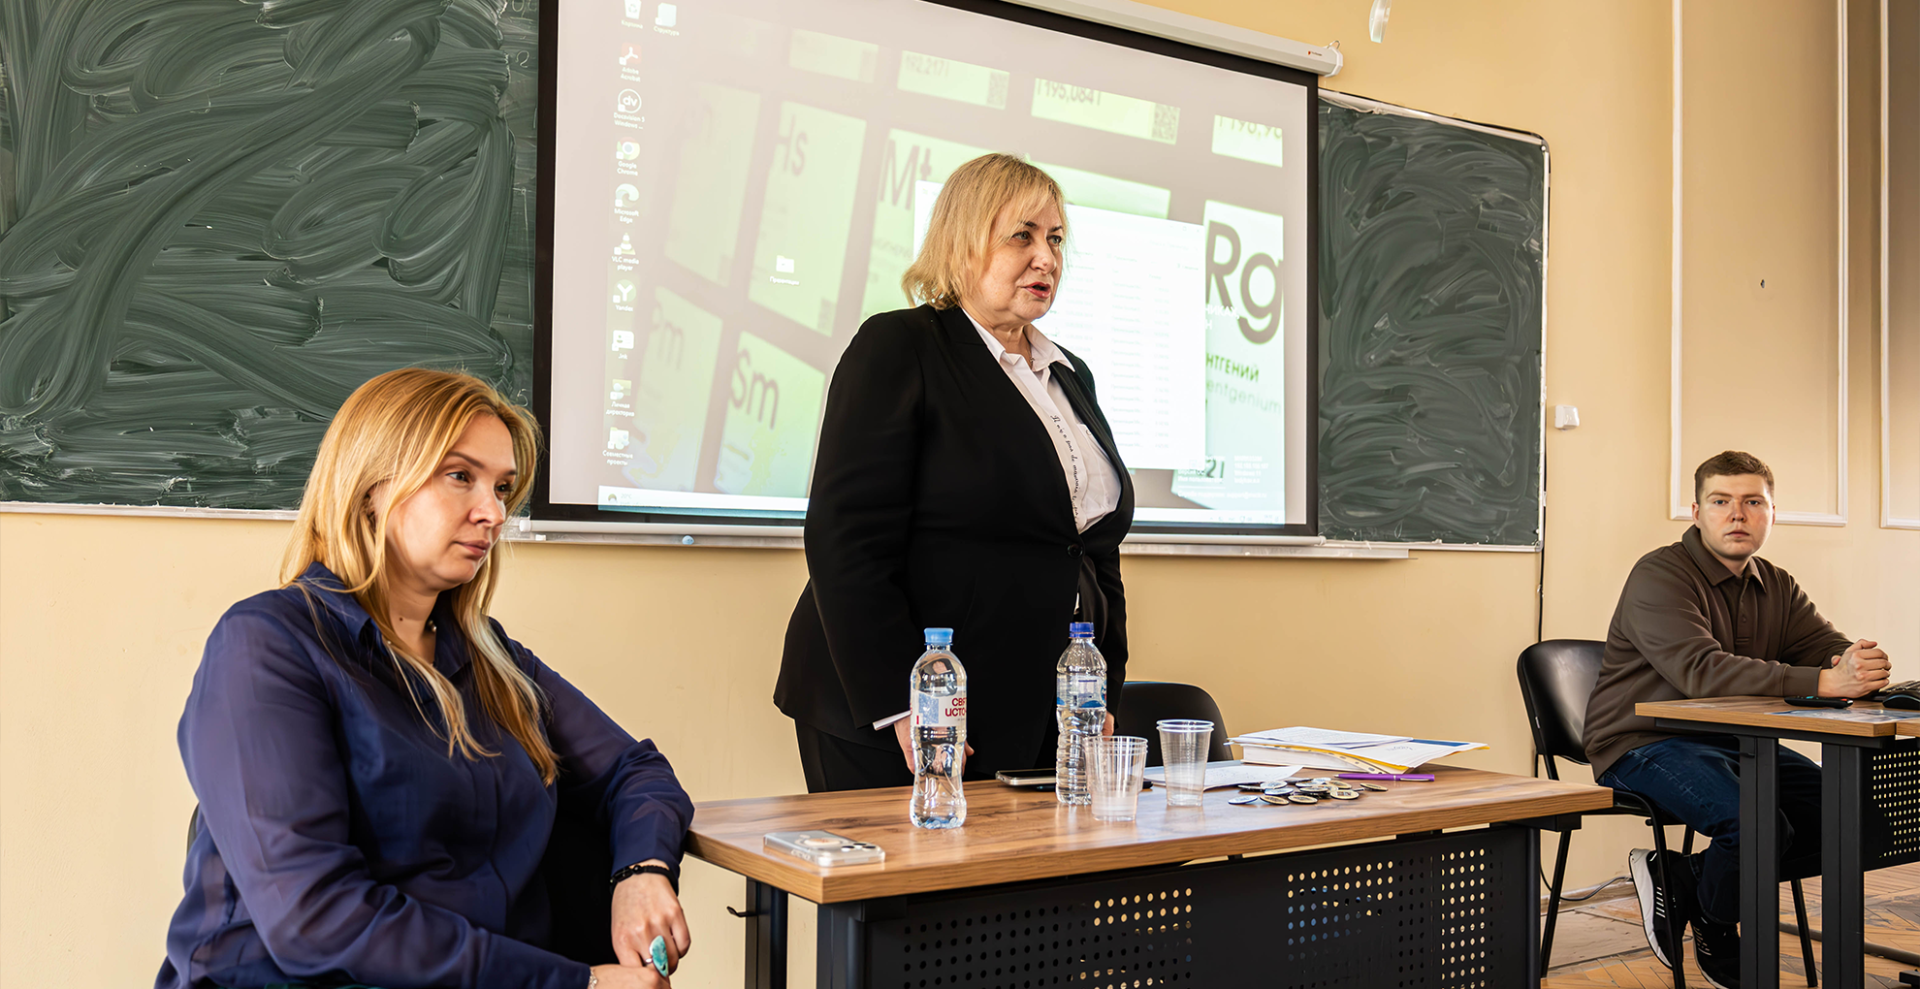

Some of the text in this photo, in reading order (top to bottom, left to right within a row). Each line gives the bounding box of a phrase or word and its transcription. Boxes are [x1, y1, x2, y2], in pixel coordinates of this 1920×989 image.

[622, 66, 639, 75] Adobe
[620, 73, 641, 82] Acrobat
[614, 119, 638, 129] Windows
[618, 161, 637, 169] Google
[616, 168, 638, 176] Chrome
[614, 207, 639, 217] Microsoft
[619, 215, 633, 224] Edge
[617, 264, 633, 272] player
[1206, 220, 1283, 345] Rg
[615, 304, 634, 312] Yandex
[1205, 304, 1240, 320] НИКАХ,
[1206, 352, 1260, 383] НТГЕНИЙ
[731, 348, 780, 430] Sm
[1206, 379, 1282, 415] entgenium
[945, 707, 967, 717] ИСТО
